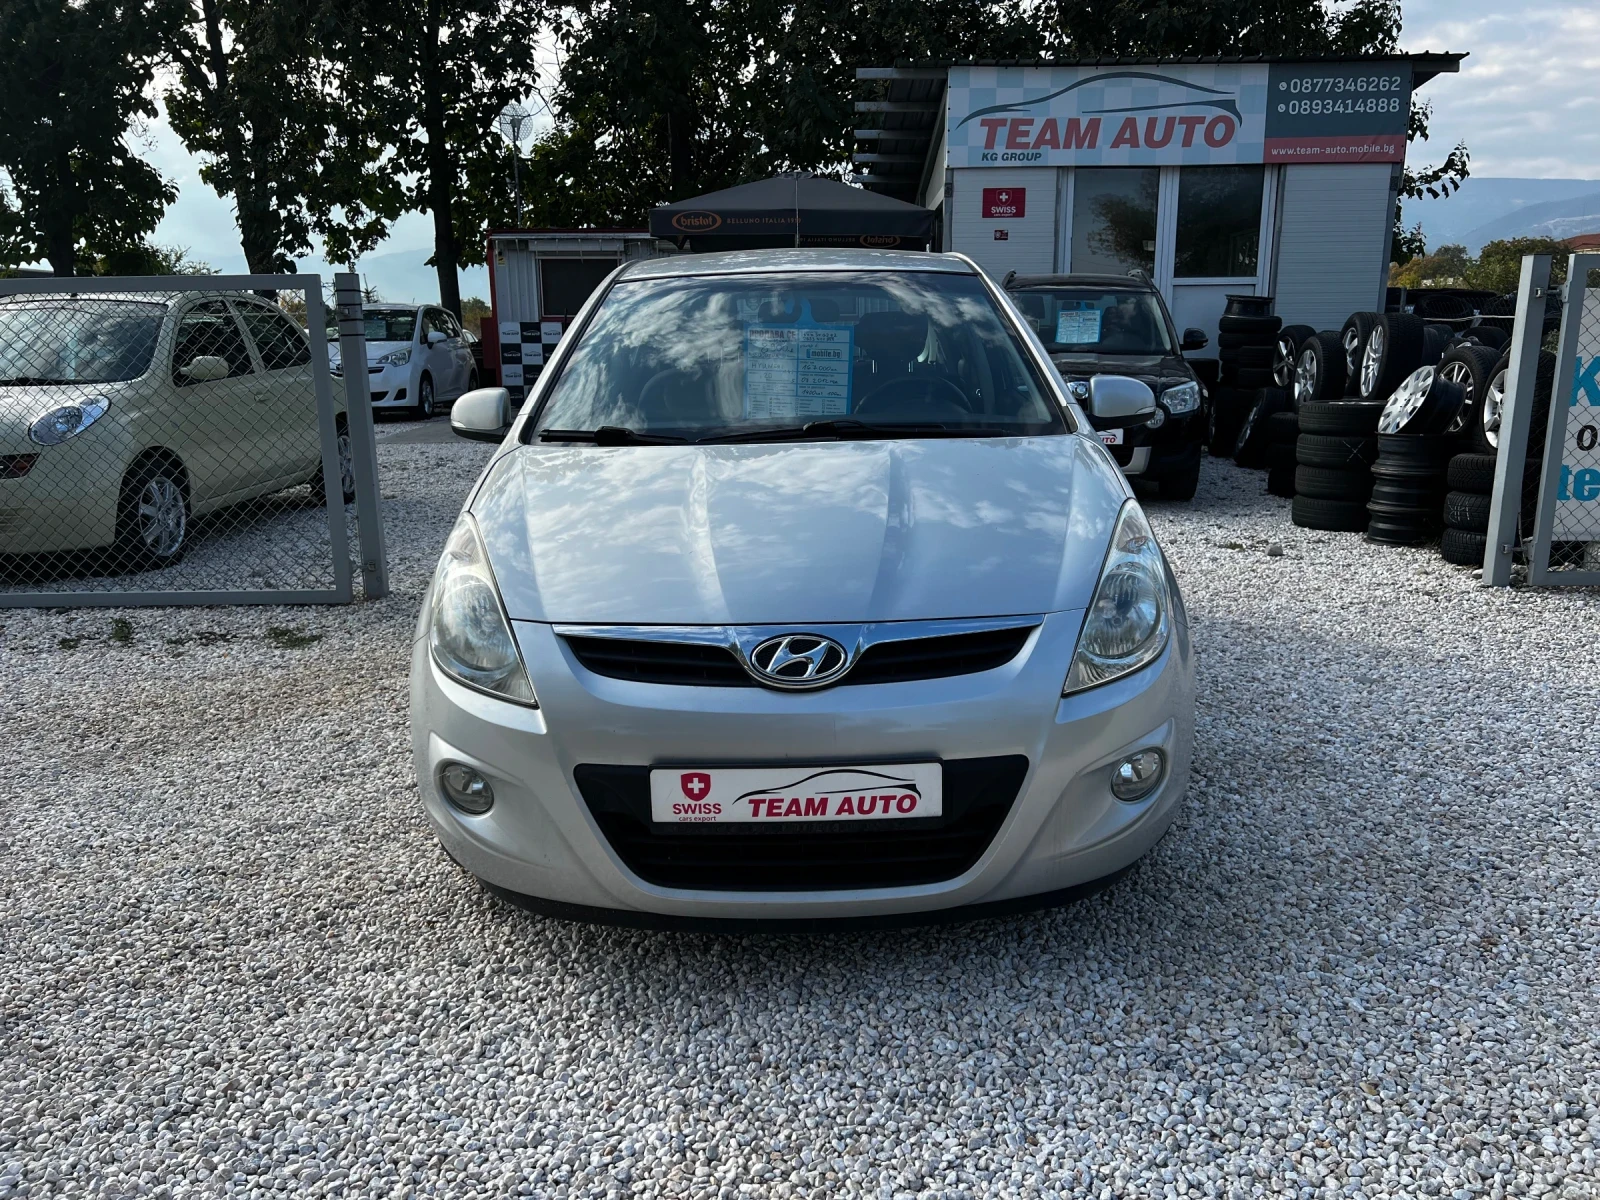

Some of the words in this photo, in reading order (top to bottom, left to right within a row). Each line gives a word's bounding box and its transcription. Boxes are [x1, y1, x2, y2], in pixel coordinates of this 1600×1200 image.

[1290, 76, 1401, 93] 0877346262
[1288, 98, 1400, 115] 0893414888
[979, 117, 1101, 151] TEAM
[1109, 114, 1235, 149] AUTO
[1271, 143, 1395, 155] www.team-auto.mobile.bg
[981, 152, 999, 162] KG
[1001, 151, 1042, 162] GROUP
[990, 206, 1017, 214] SWISS
[680, 215, 713, 226] bristot
[811, 350, 841, 359] mobile.bg
[672, 802, 722, 815] SWISS
[748, 798, 829, 818] TEAM
[835, 794, 917, 816] AUTO
[694, 815, 717, 823] export
